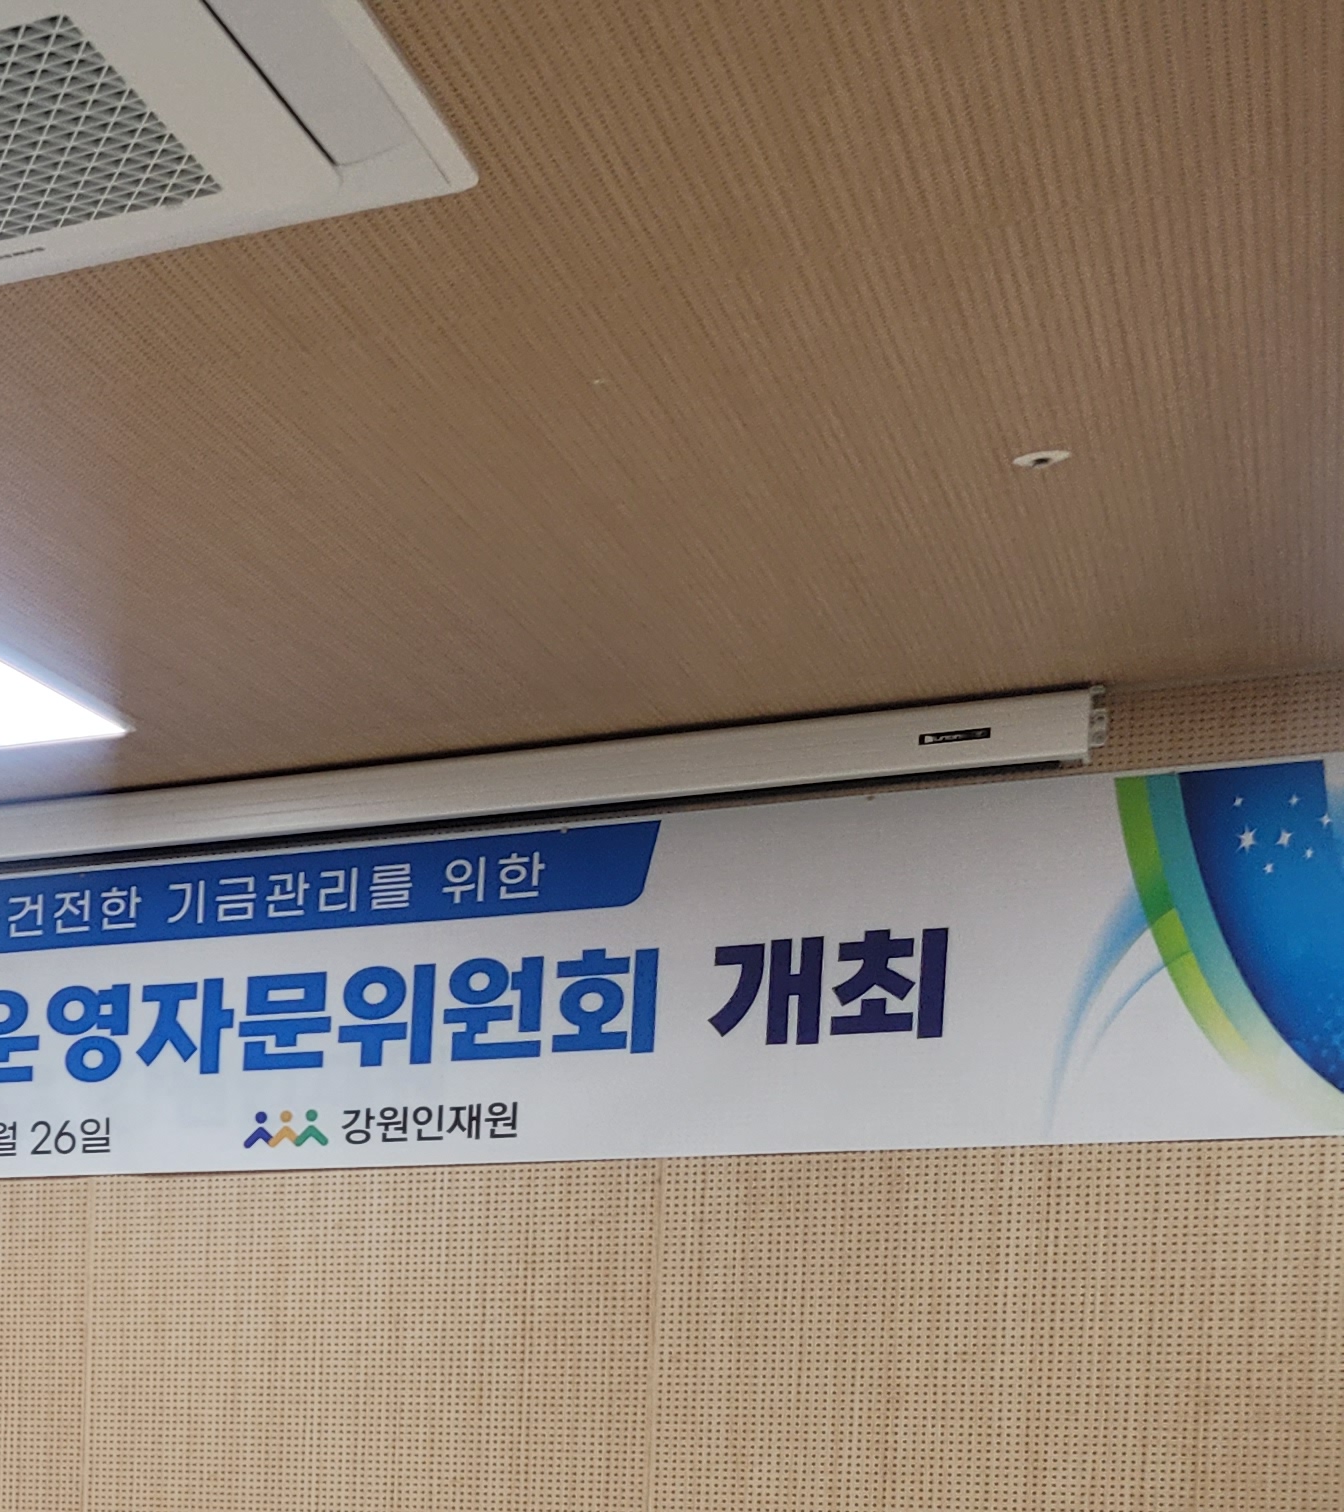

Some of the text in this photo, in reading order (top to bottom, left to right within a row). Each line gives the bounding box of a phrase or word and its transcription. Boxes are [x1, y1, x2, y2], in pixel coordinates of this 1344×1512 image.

[8, 885, 142, 938] 건전한
[167, 862, 412, 924] 기금관리를
[441, 851, 545, 904] 위한
[708, 926, 949, 1046] 개최
[29, 1117, 112, 1156] 26일
[341, 1101, 519, 1145] 강원인재원
